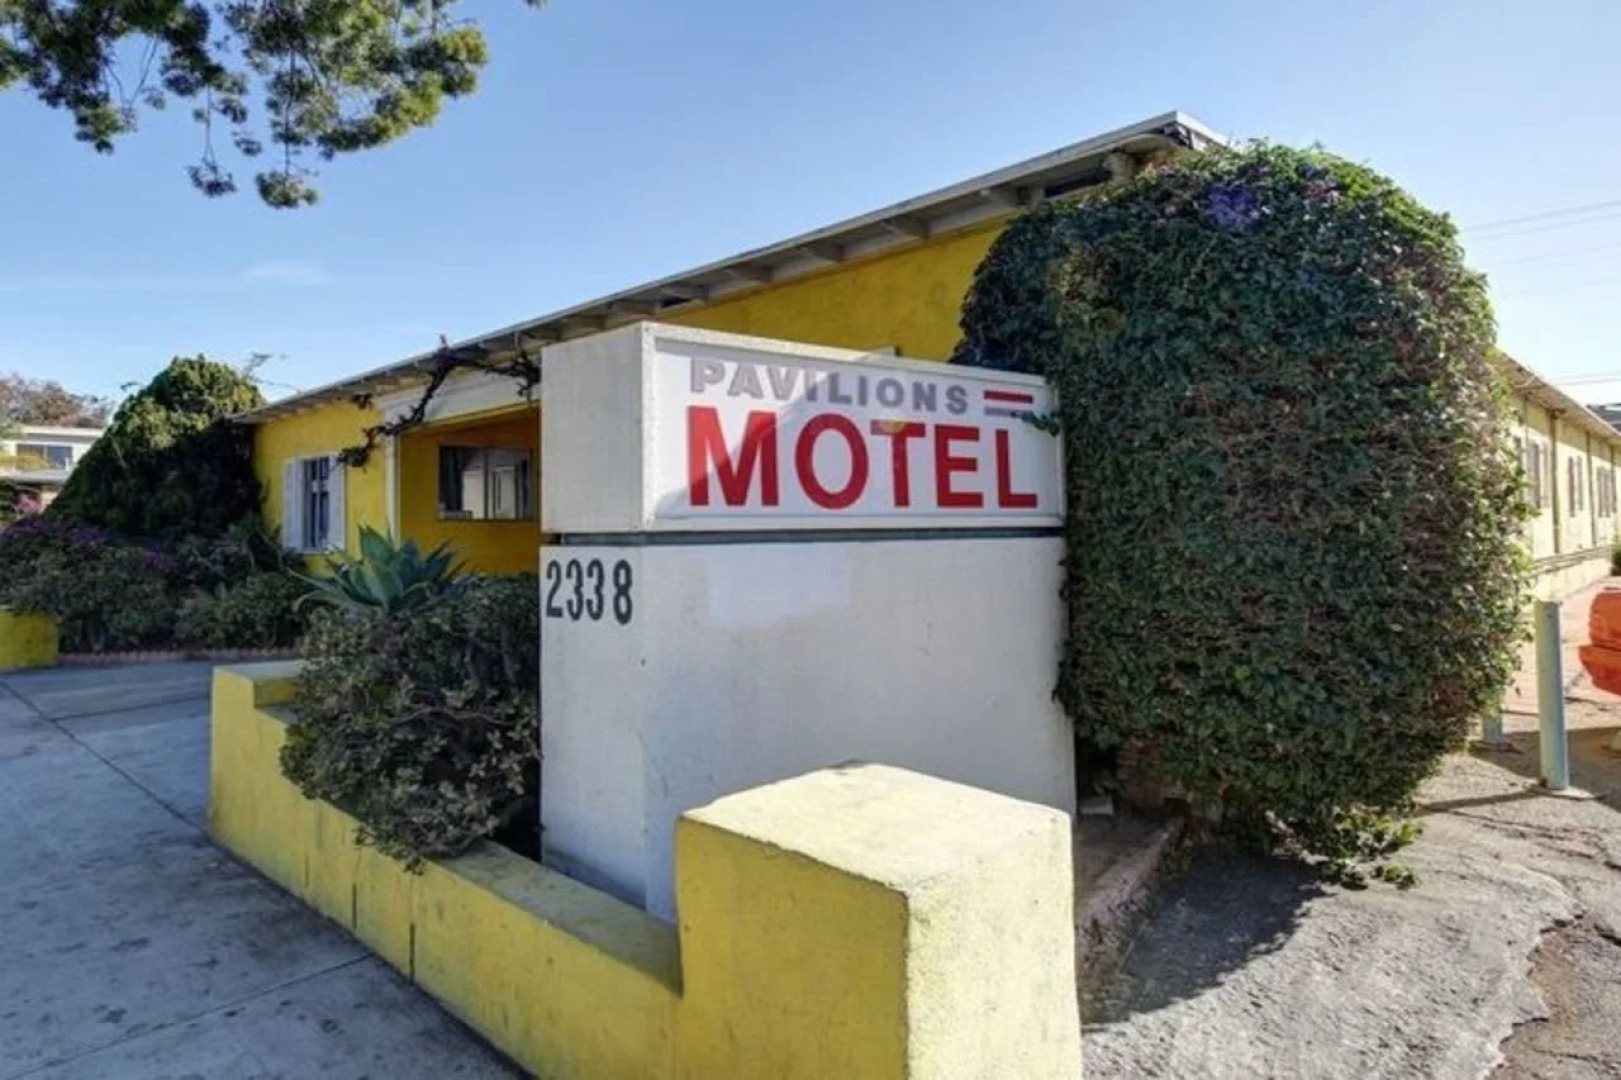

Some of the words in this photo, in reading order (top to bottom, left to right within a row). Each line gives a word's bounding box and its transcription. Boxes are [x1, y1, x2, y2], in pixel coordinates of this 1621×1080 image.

[690, 357, 968, 416] PAVILIONS
[687, 405, 1038, 510] MOTEL
[546, 558, 633, 625] 2338
